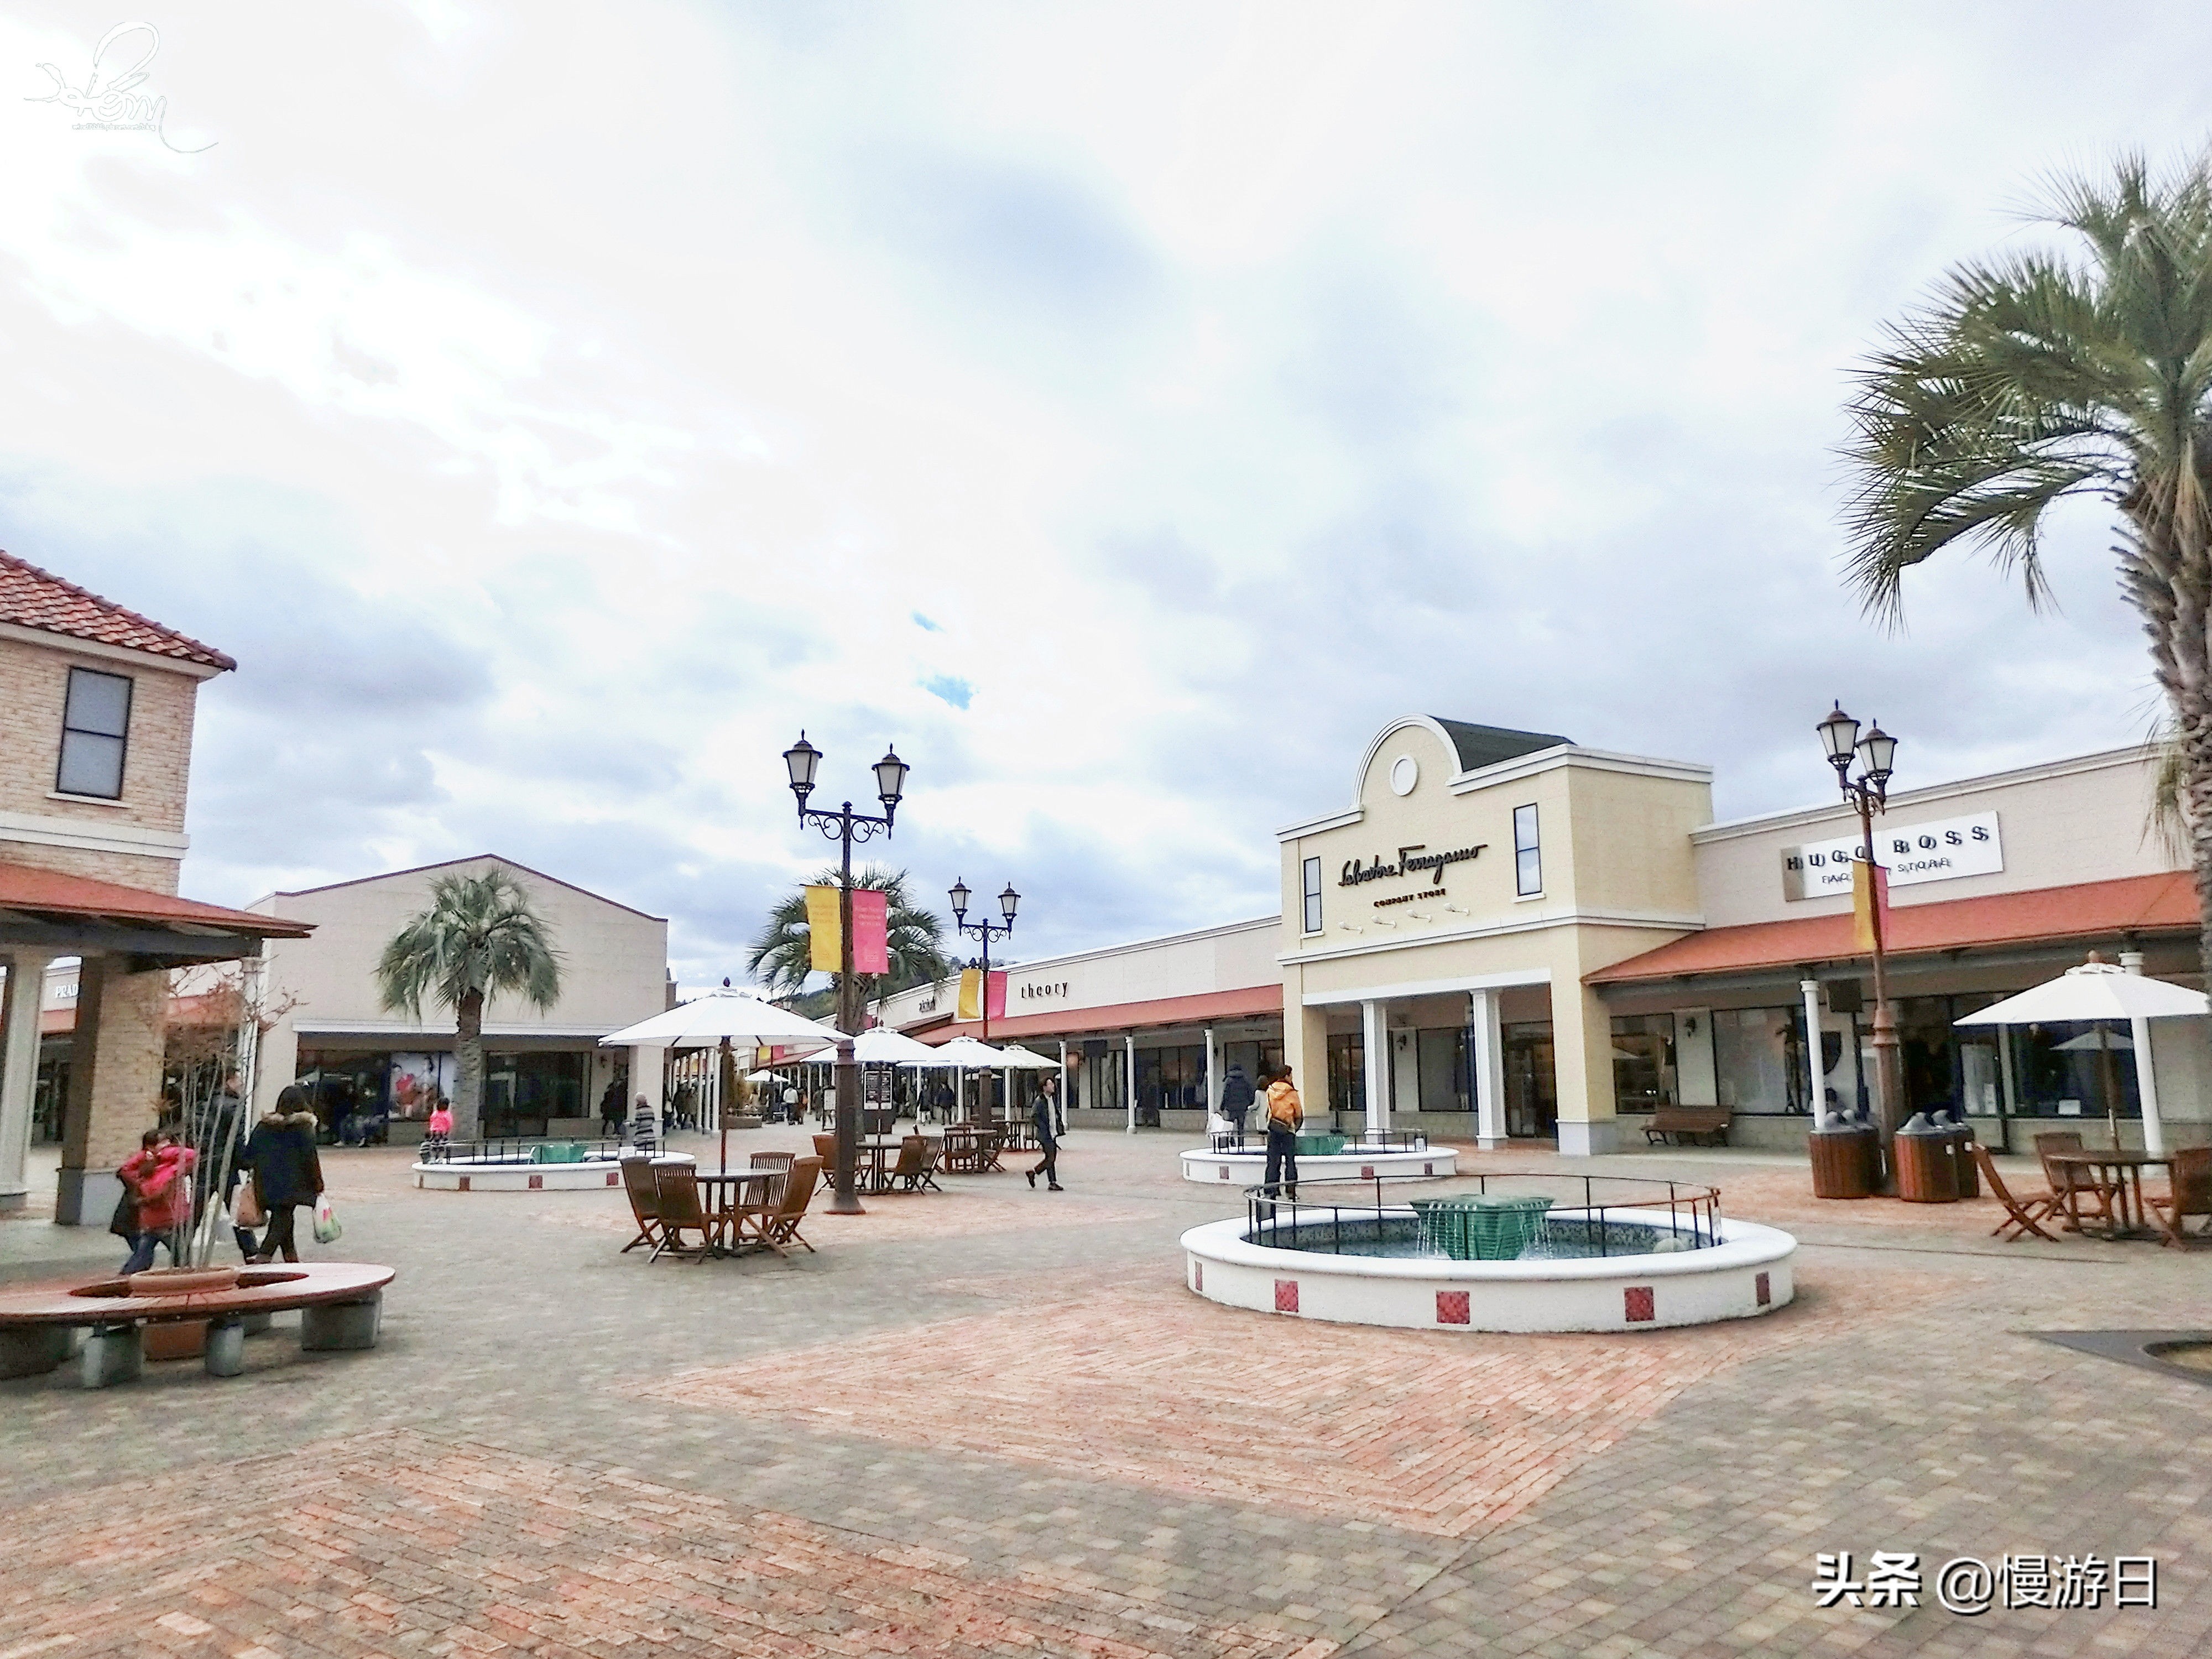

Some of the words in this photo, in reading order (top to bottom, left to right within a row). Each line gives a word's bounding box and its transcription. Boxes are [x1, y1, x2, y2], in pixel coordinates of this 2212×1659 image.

[1892, 826, 1989, 853] BOSS
[1337, 854, 1399, 886] Salvatore
[1398, 844, 1489, 885] Ferragamo
[1897, 858, 1951, 872] STORE
[55, 984, 79, 998] PRAD
[1021, 982, 1068, 999] theory
